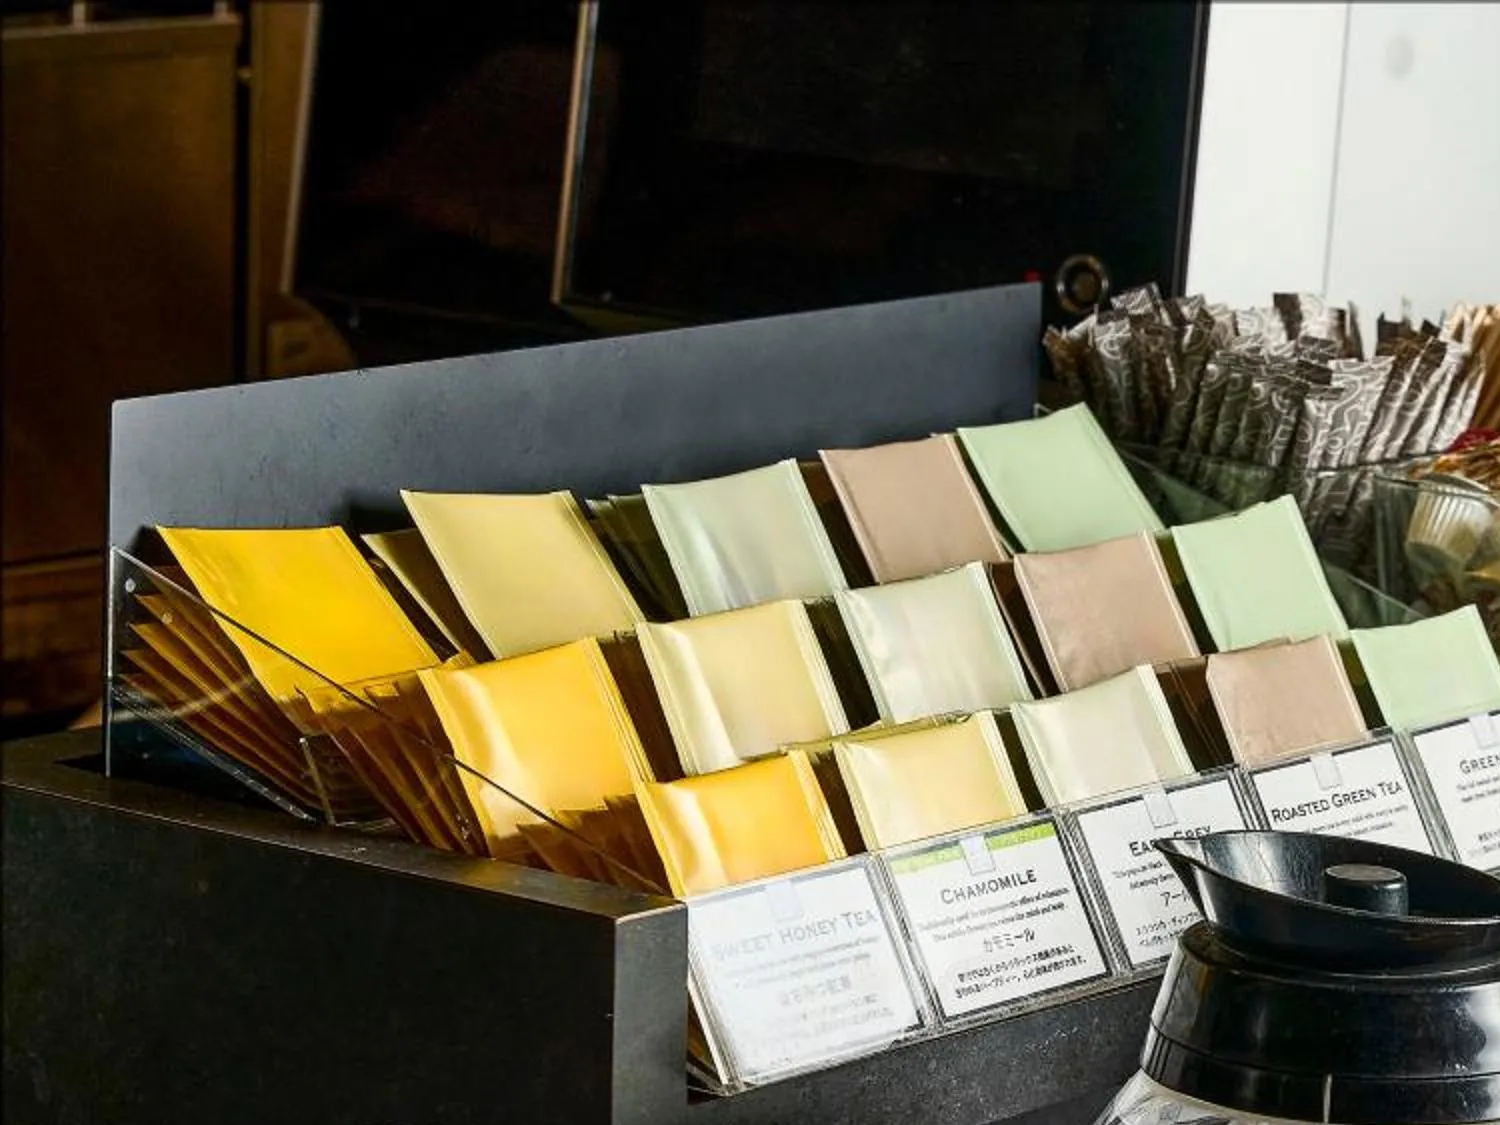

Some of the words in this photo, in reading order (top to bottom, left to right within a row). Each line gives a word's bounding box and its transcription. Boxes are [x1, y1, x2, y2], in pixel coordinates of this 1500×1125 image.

[1271, 799, 1331, 823] ROASTED
[1331, 787, 1377, 808] GREEN
[1377, 781, 1403, 797] TEA
[940, 868, 1037, 904] CHAMOMILE
[778, 918, 838, 945] HONEY
